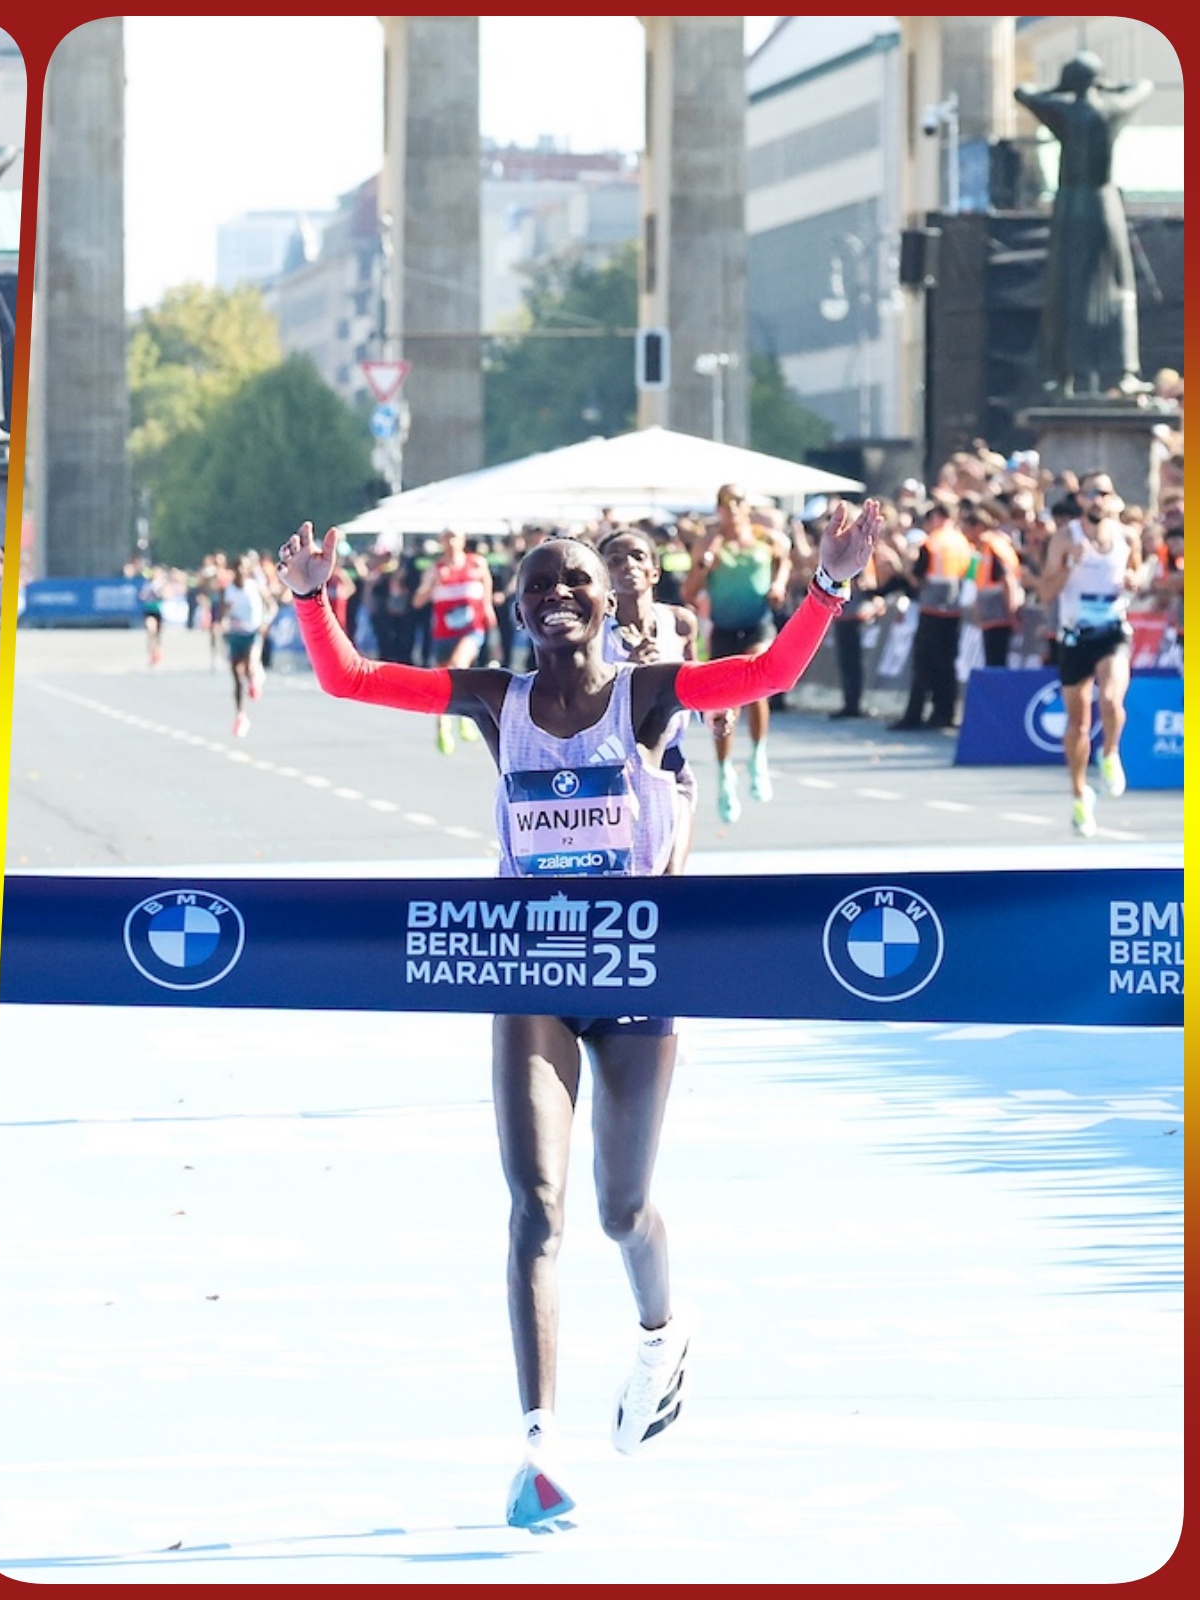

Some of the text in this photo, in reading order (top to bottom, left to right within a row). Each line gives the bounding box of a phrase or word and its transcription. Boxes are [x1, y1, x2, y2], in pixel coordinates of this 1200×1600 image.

[516, 806, 621, 832] WANJIRU
[536, 852, 604, 870] zalando
[143, 894, 229, 916] BMW
[407, 900, 521, 930] BMW
[841, 891, 927, 922] BMW
[592, 900, 660, 940] 20
[1110, 901, 1184, 937] BM
[406, 931, 520, 957] BERLIN
[406, 960, 587, 986] MARATHON
[592, 943, 658, 987] 25
[1110, 970, 1184, 995] MAR
